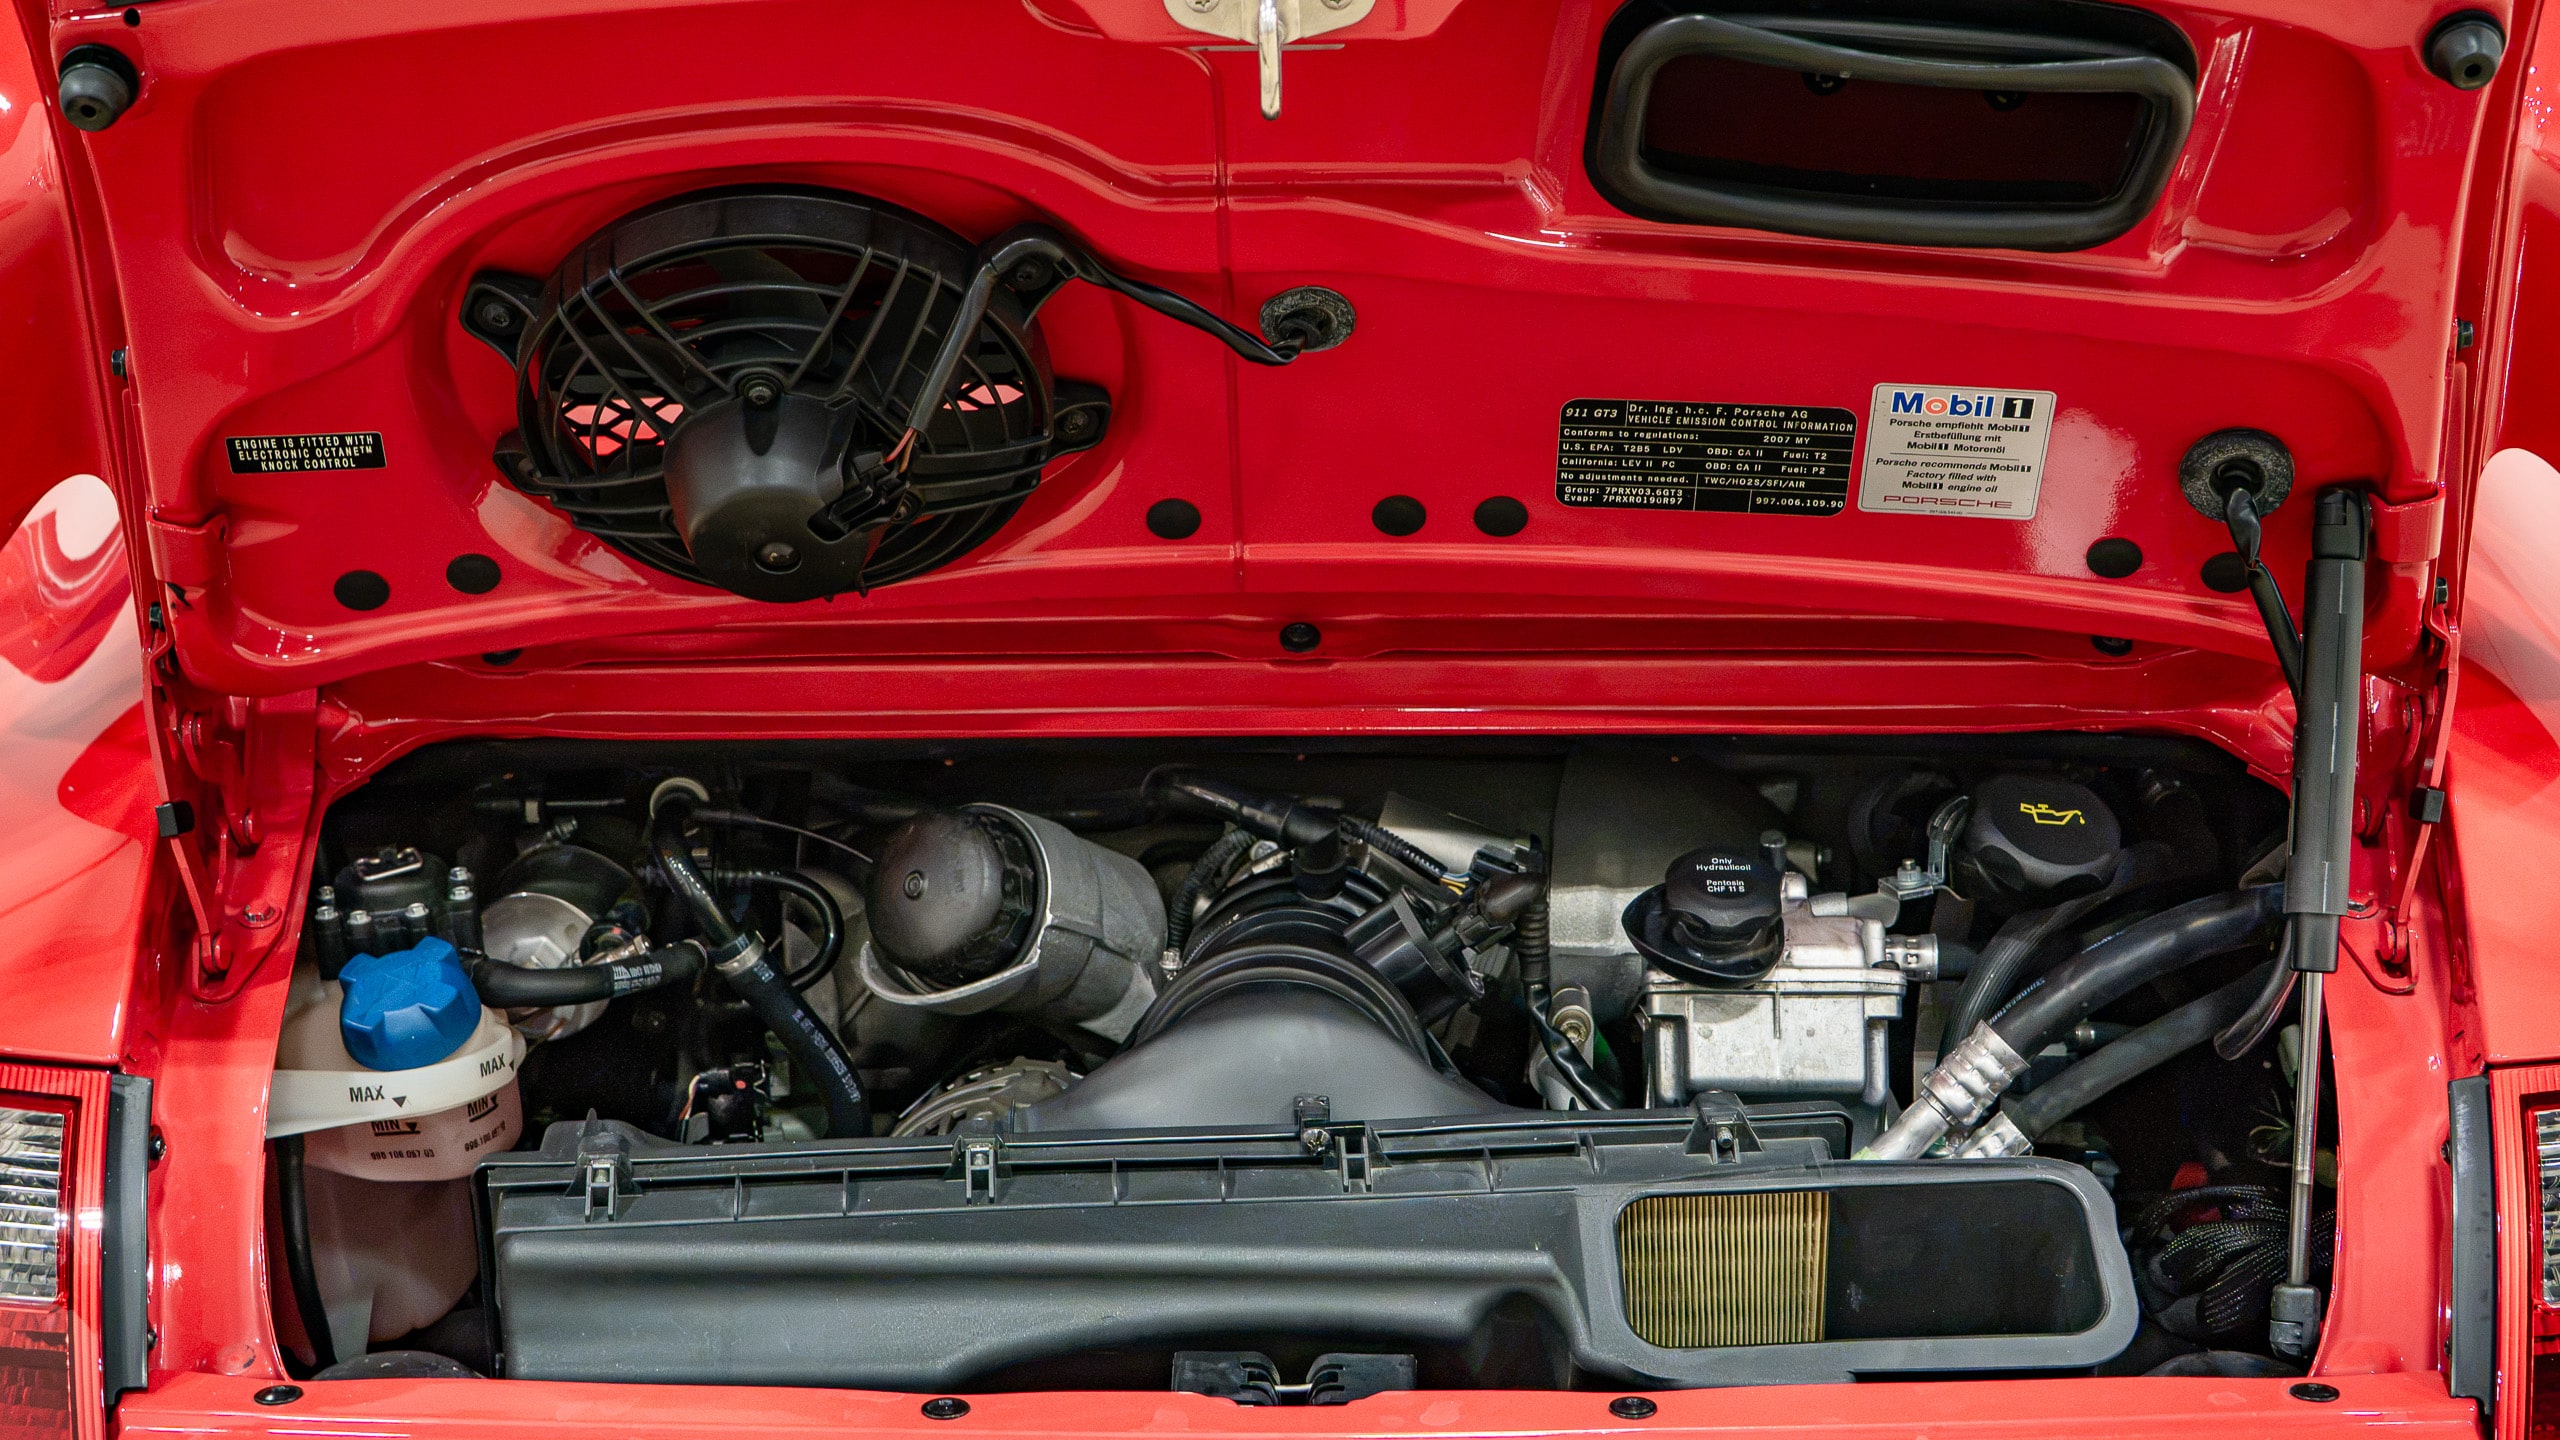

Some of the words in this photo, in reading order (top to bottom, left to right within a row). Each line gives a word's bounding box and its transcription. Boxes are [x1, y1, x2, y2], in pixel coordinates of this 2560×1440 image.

[1892, 392, 1994, 417] Mobil
[1566, 408, 1588, 417] 911
[1594, 409, 1618, 418] GT3
[1630, 404, 1648, 413] Dr.
[1654, 405, 1679, 415] Ing.
[1685, 406, 1709, 415] h.c.
[1716, 407, 1727, 415] F.
[1734, 407, 1786, 418] Porsche
[1791, 410, 1808, 419] AG
[1628, 415, 1671, 424] VEHICLE
[1676, 416, 1725, 426] EMISSION
[1731, 418, 1778, 428] CONTROL
[1783, 420, 1853, 432] INFORMATION
[1889, 418, 1931, 428] Porsche
[1935, 421, 1984, 431] empfiehlt
[235, 439, 277, 450] ENGINE
[282, 438, 294, 448] IS
[300, 436, 340, 448] FITTED
[345, 434, 374, 446] WITH
[1563, 428, 1614, 436] Conforms
[1619, 430, 1629, 438] to
[1634, 431, 1699, 440] regulations:
[1763, 435, 1790, 443] 2007
[1795, 437, 1811, 445] MY
[1914, 430, 1981, 443] Erstbefüllung
[1984, 434, 2002, 442] mit
[238, 448, 310, 461] ELECTRONIC
[1562, 442, 1585, 451] U.S.
[1589, 443, 1614, 452] EPA:
[1623, 444, 1650, 453] T2B5
[1663, 446, 1683, 454] LDV
[1707, 447, 1733, 456] OBD:
[1737, 448, 1751, 457] CA
[1783, 450, 1809, 460] Fuel:
[1814, 452, 1827, 460] T2
[1953, 443, 2005, 454] Motorenöl
[261, 459, 299, 472] KNOCK
[304, 457, 356, 470] CONTROL
[1562, 457, 1618, 467] California:
[1622, 459, 1642, 467] LEV
[1661, 460, 1675, 468] PC
[1705, 462, 1731, 471] OBD:
[1736, 463, 1750, 471] CA
[1781, 465, 1807, 474] Fuel:
[1812, 467, 1826, 475] P2
[1875, 457, 1917, 467] Porsche
[1920, 461, 1987, 471] recommends
[1560, 472, 1574, 480] No
[1579, 472, 1643, 482] adjustments
[1647, 475, 1689, 483] needed.
[1906, 470, 1945, 480] Factory
[1948, 472, 1974, 481] filled
[1976, 473, 1997, 482] with
[1565, 485, 1600, 495] Group:
[1947, 484, 1982, 493] engine
[1985, 485, 1998, 493] oil
[1564, 494, 1593, 503] Evap:
[1756, 497, 1844, 509] 997.006.109.90
[1883, 495, 2013, 509] PORSCHE
[1711, 857, 1732, 865] Only
[479, 1053, 505, 1077] MAX
[349, 1085, 385, 1102] MAX
[467, 1095, 489, 1117] MIN
[371, 1119, 400, 1132] MIN
